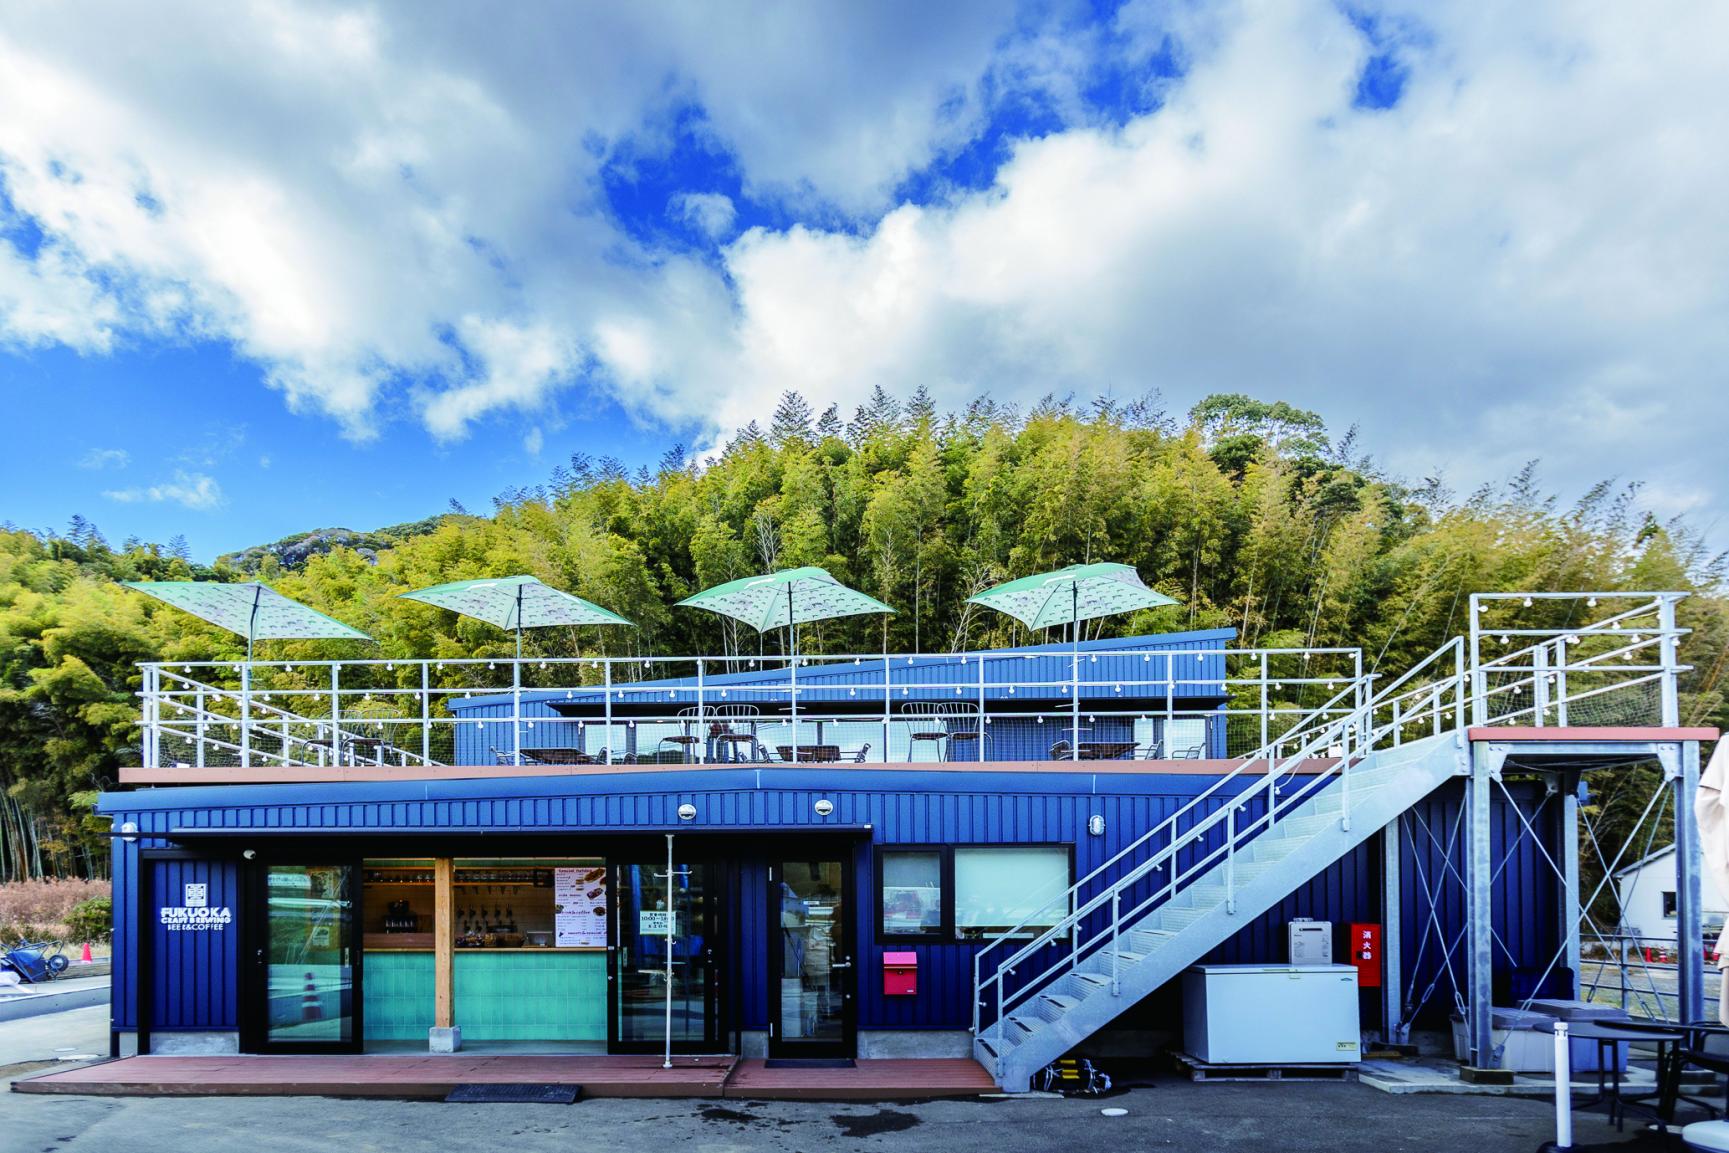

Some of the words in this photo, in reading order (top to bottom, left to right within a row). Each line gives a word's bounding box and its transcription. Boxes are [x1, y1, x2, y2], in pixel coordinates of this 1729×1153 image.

[161, 907, 231, 918] FUKUOKA
[1362, 930, 1372, 960] 消火器
